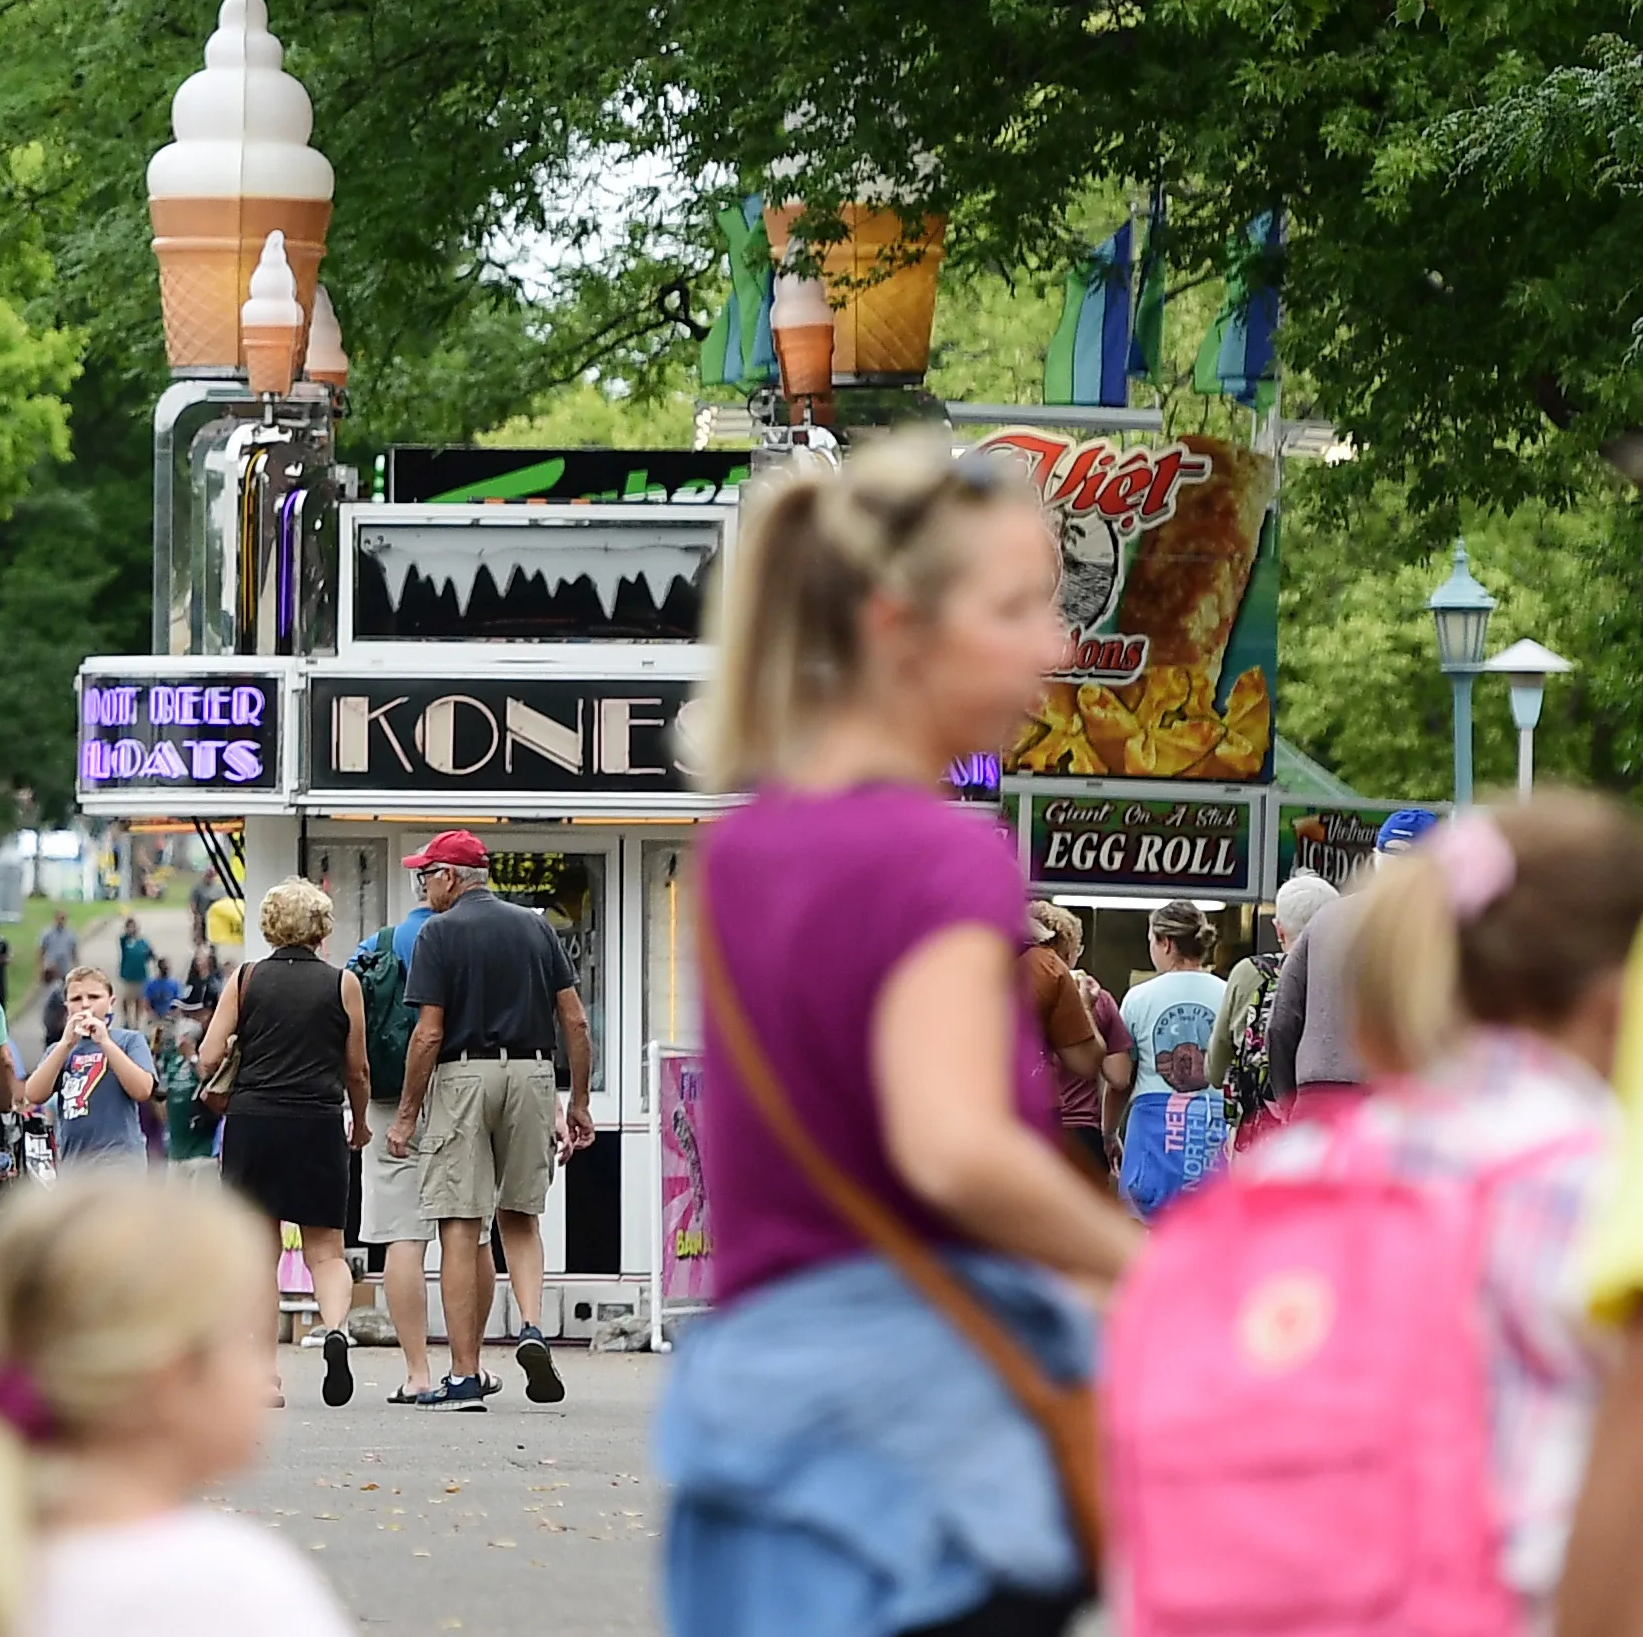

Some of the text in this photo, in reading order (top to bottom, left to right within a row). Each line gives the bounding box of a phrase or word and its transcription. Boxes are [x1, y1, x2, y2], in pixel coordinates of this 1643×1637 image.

[149, 686, 265, 726] BEER
[1045, 799, 1238, 827] Giant On A Stick
[1322, 813, 1378, 842] Vietna
[1044, 830, 1236, 876] EGG ROLL
[1302, 836, 1348, 883] ICED
[1157, 1007, 1214, 1036] MOAB UTA
[1165, 1111, 1186, 1154] THE
